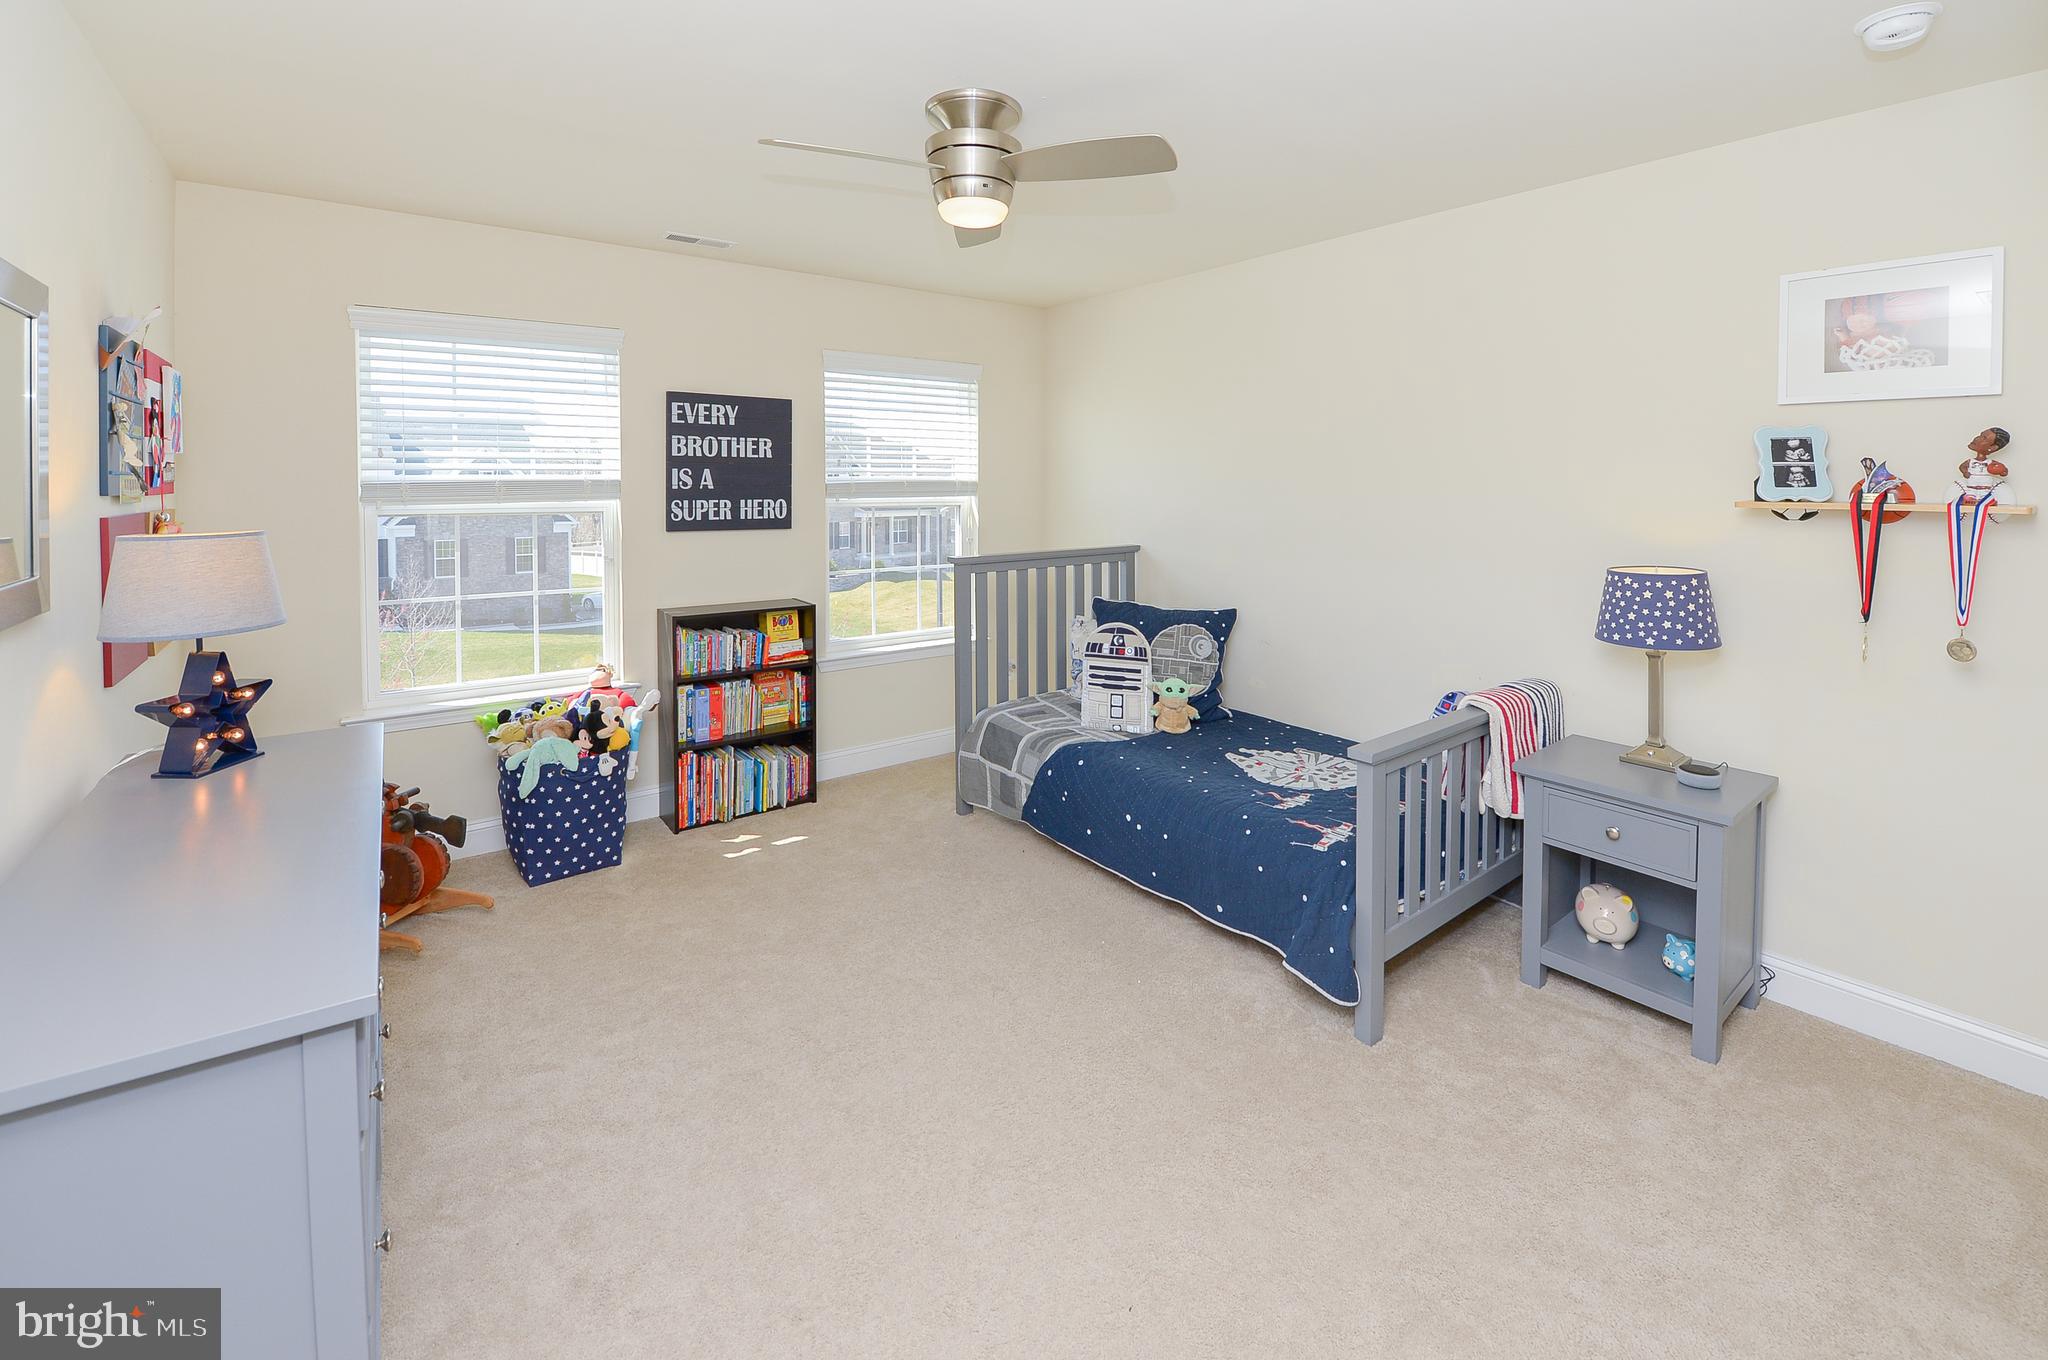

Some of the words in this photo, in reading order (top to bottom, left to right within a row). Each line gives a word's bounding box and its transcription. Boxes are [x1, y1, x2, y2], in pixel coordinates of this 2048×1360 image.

[671, 402, 739, 426] EVERY
[671, 435, 773, 459] BROTHER
[671, 467, 693, 490] IS
[699, 468, 714, 490] A
[670, 499, 732, 521] SUPER
[740, 498, 788, 520] HERO
[772, 614, 794, 628] BOB
